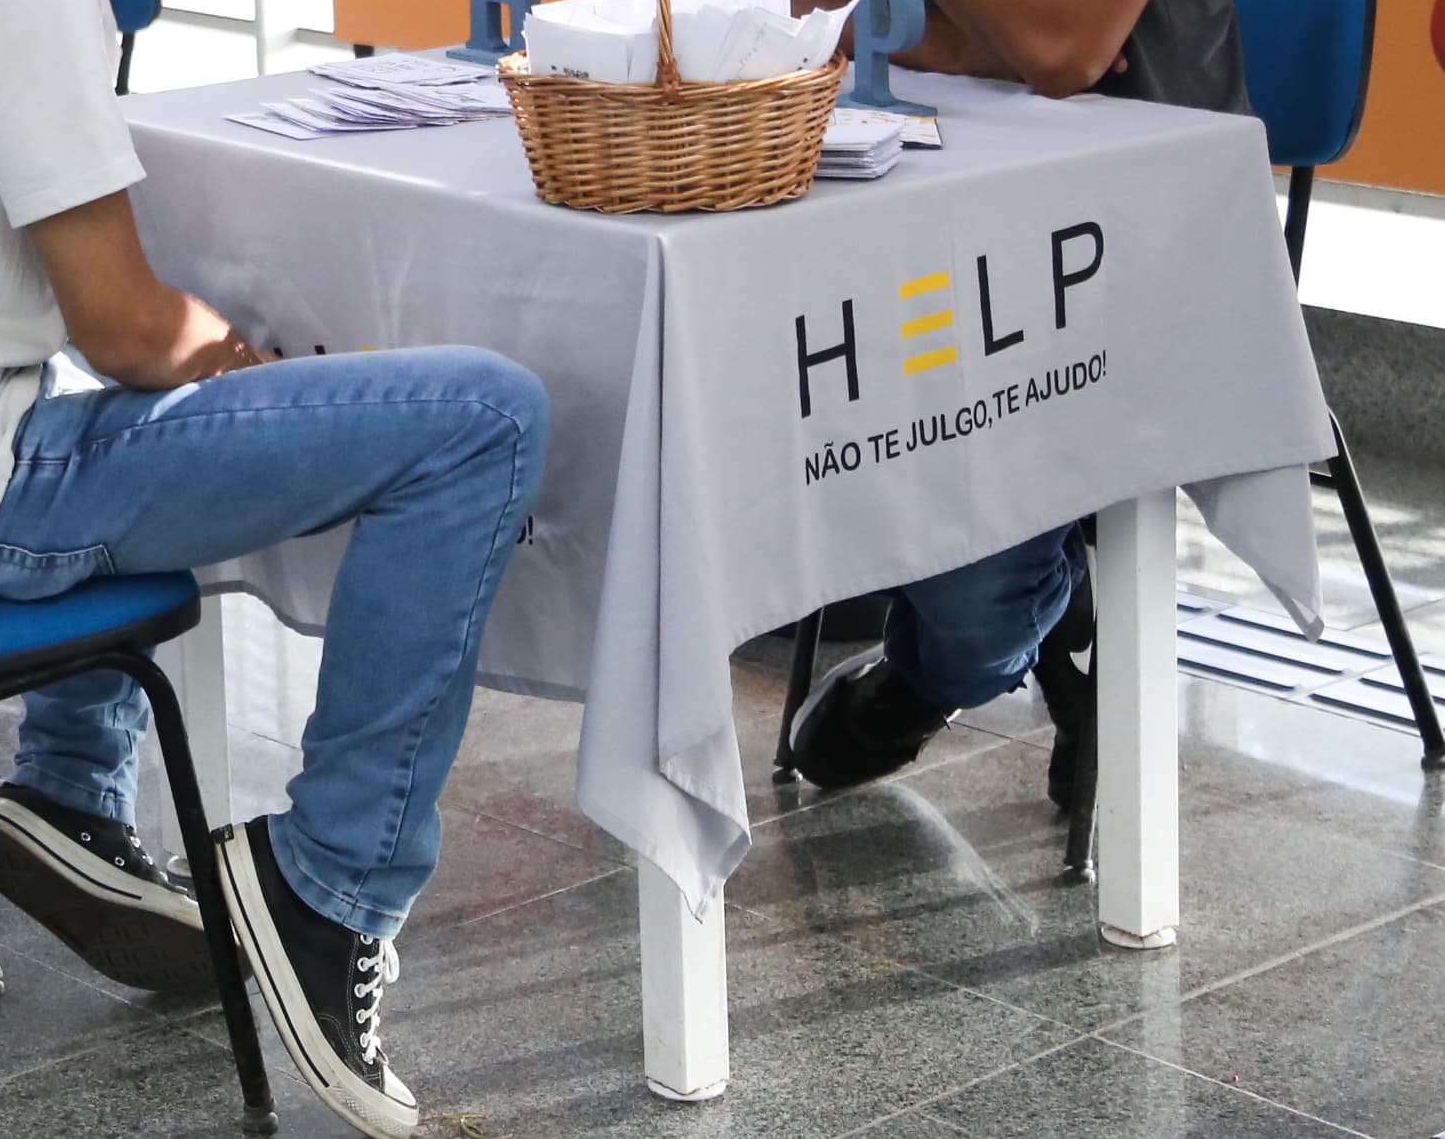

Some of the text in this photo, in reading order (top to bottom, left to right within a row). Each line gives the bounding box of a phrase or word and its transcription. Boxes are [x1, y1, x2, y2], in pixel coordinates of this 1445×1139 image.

[795, 221, 1104, 419] HELP
[804, 441, 862, 486] NÃO
[867, 429, 901, 464] TE
[1025, 350, 1107, 407] AJUDO!
